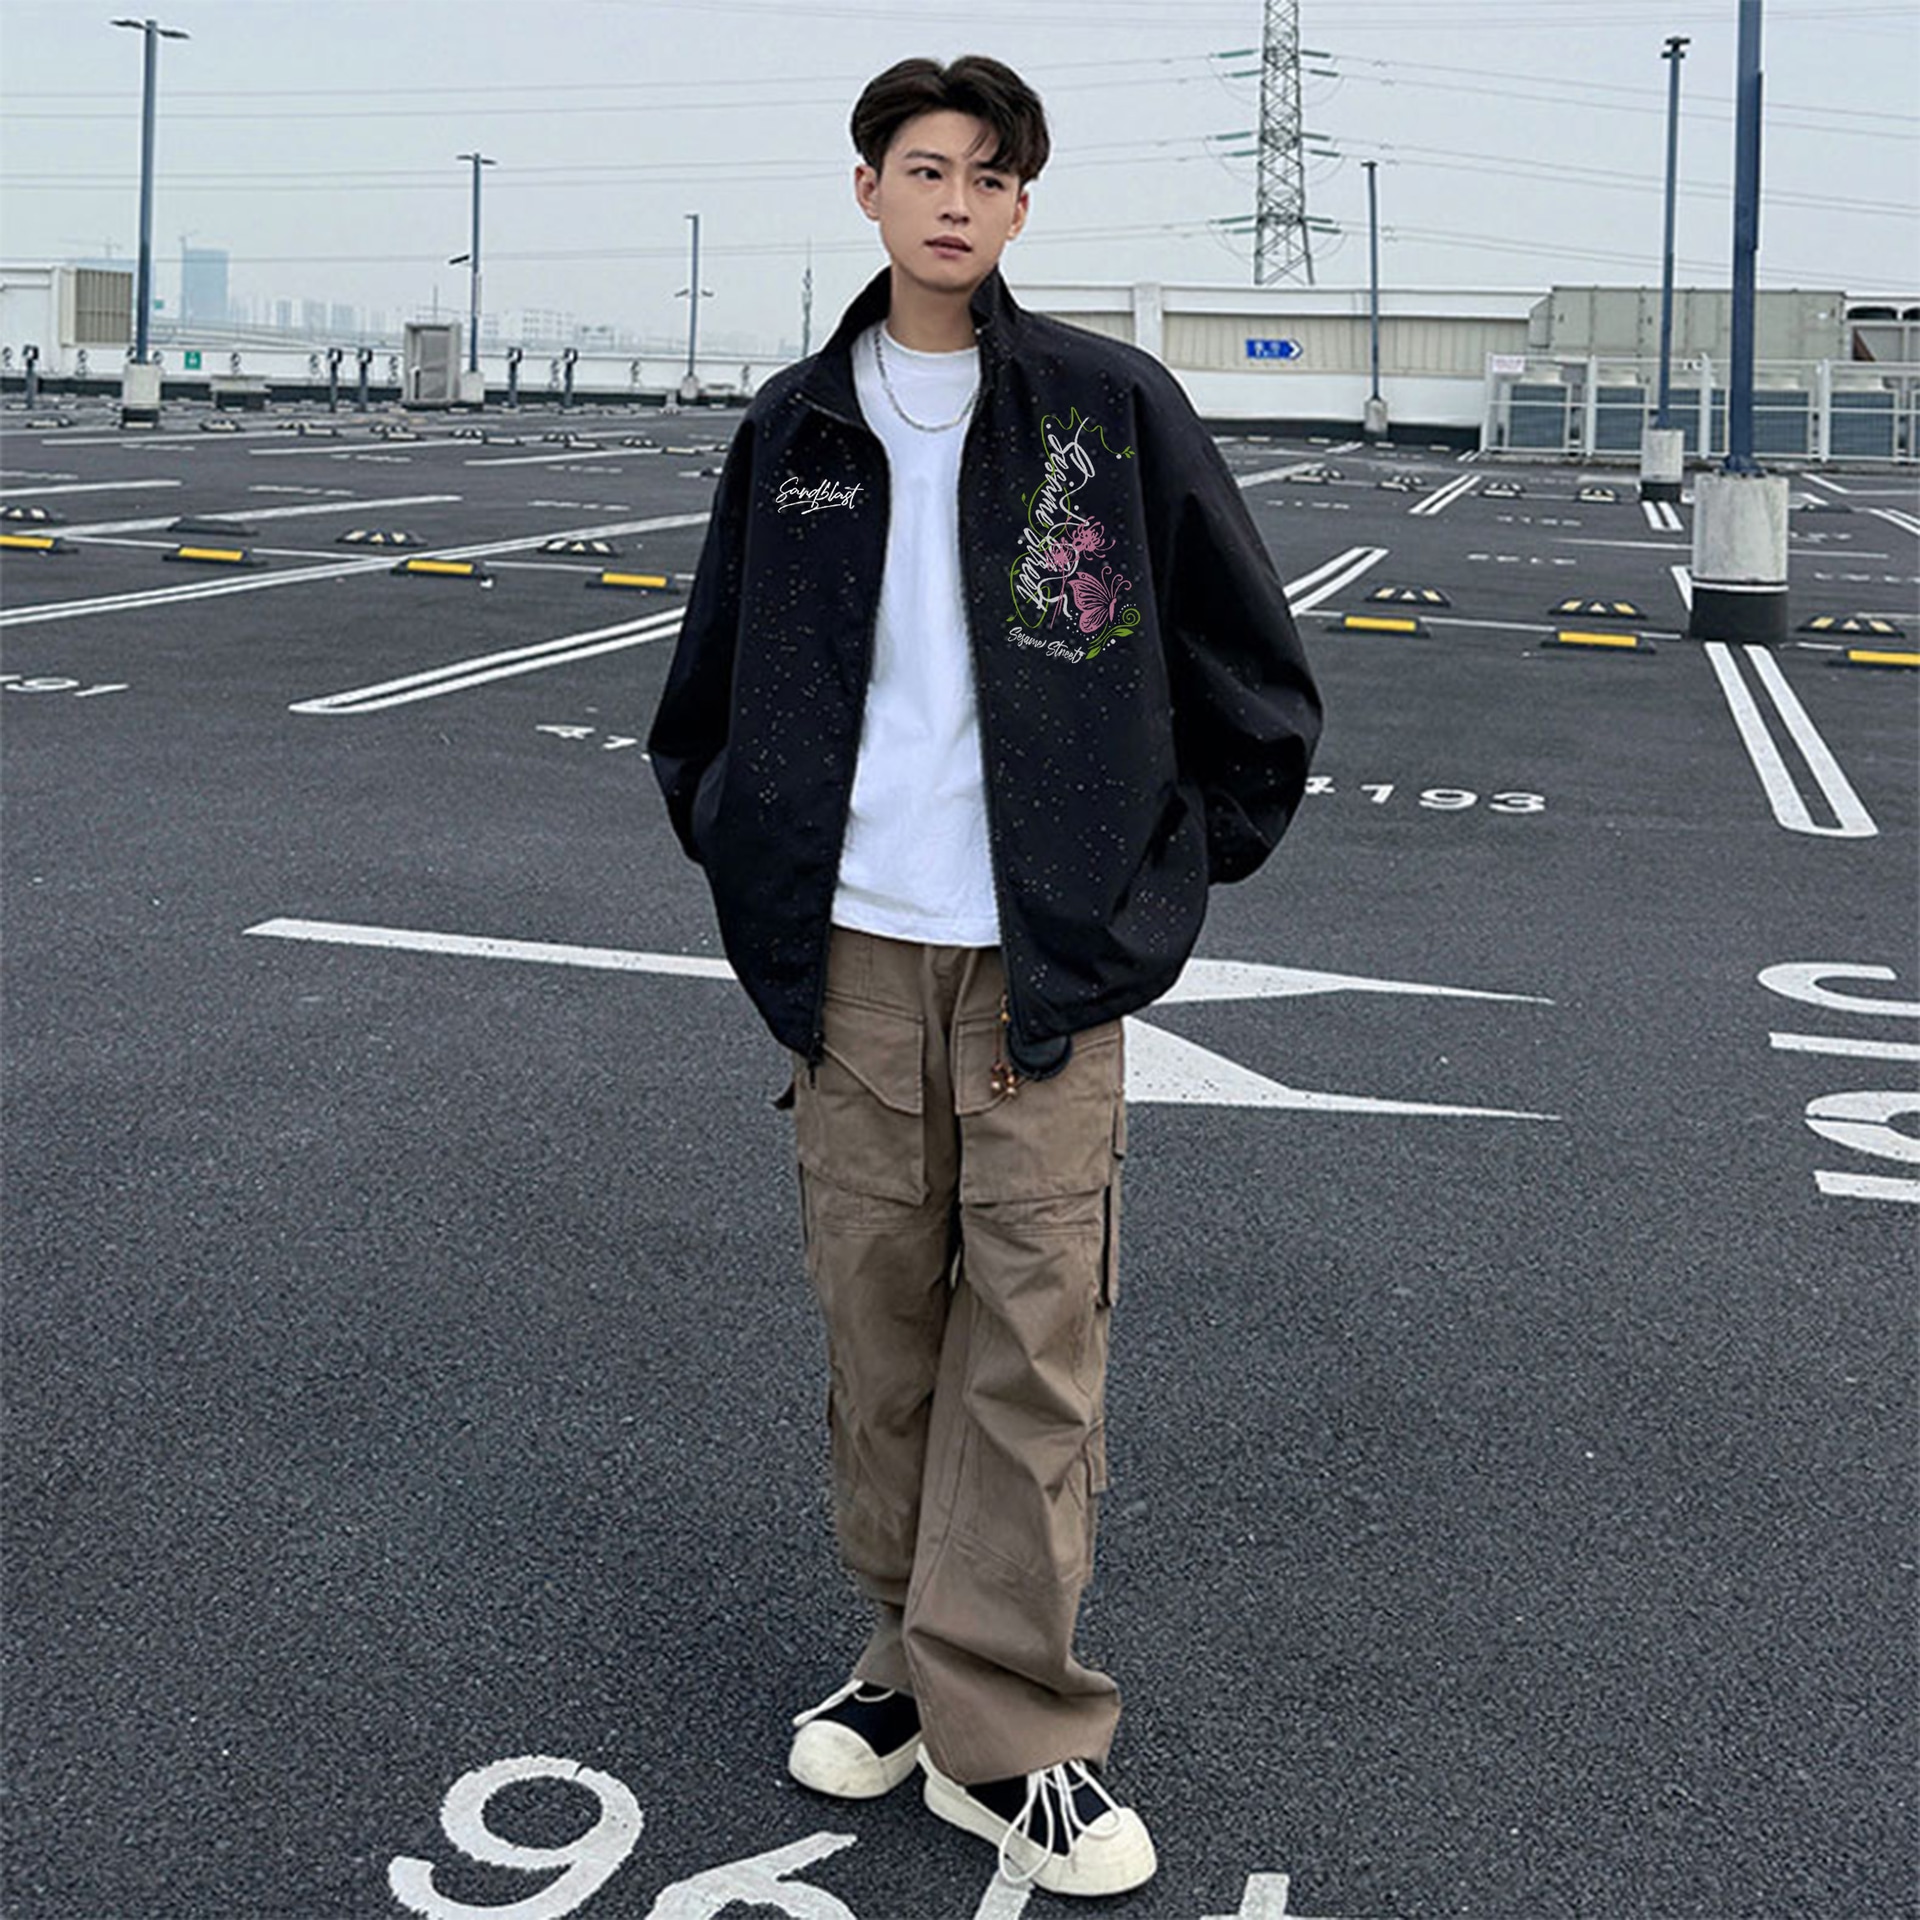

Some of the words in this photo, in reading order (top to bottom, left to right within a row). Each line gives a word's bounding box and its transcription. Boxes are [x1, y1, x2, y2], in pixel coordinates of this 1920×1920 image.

[775, 476, 864, 514] Sandblast
[1007, 626, 1048, 648] Sesame
[1045, 640, 1086, 664] Street
